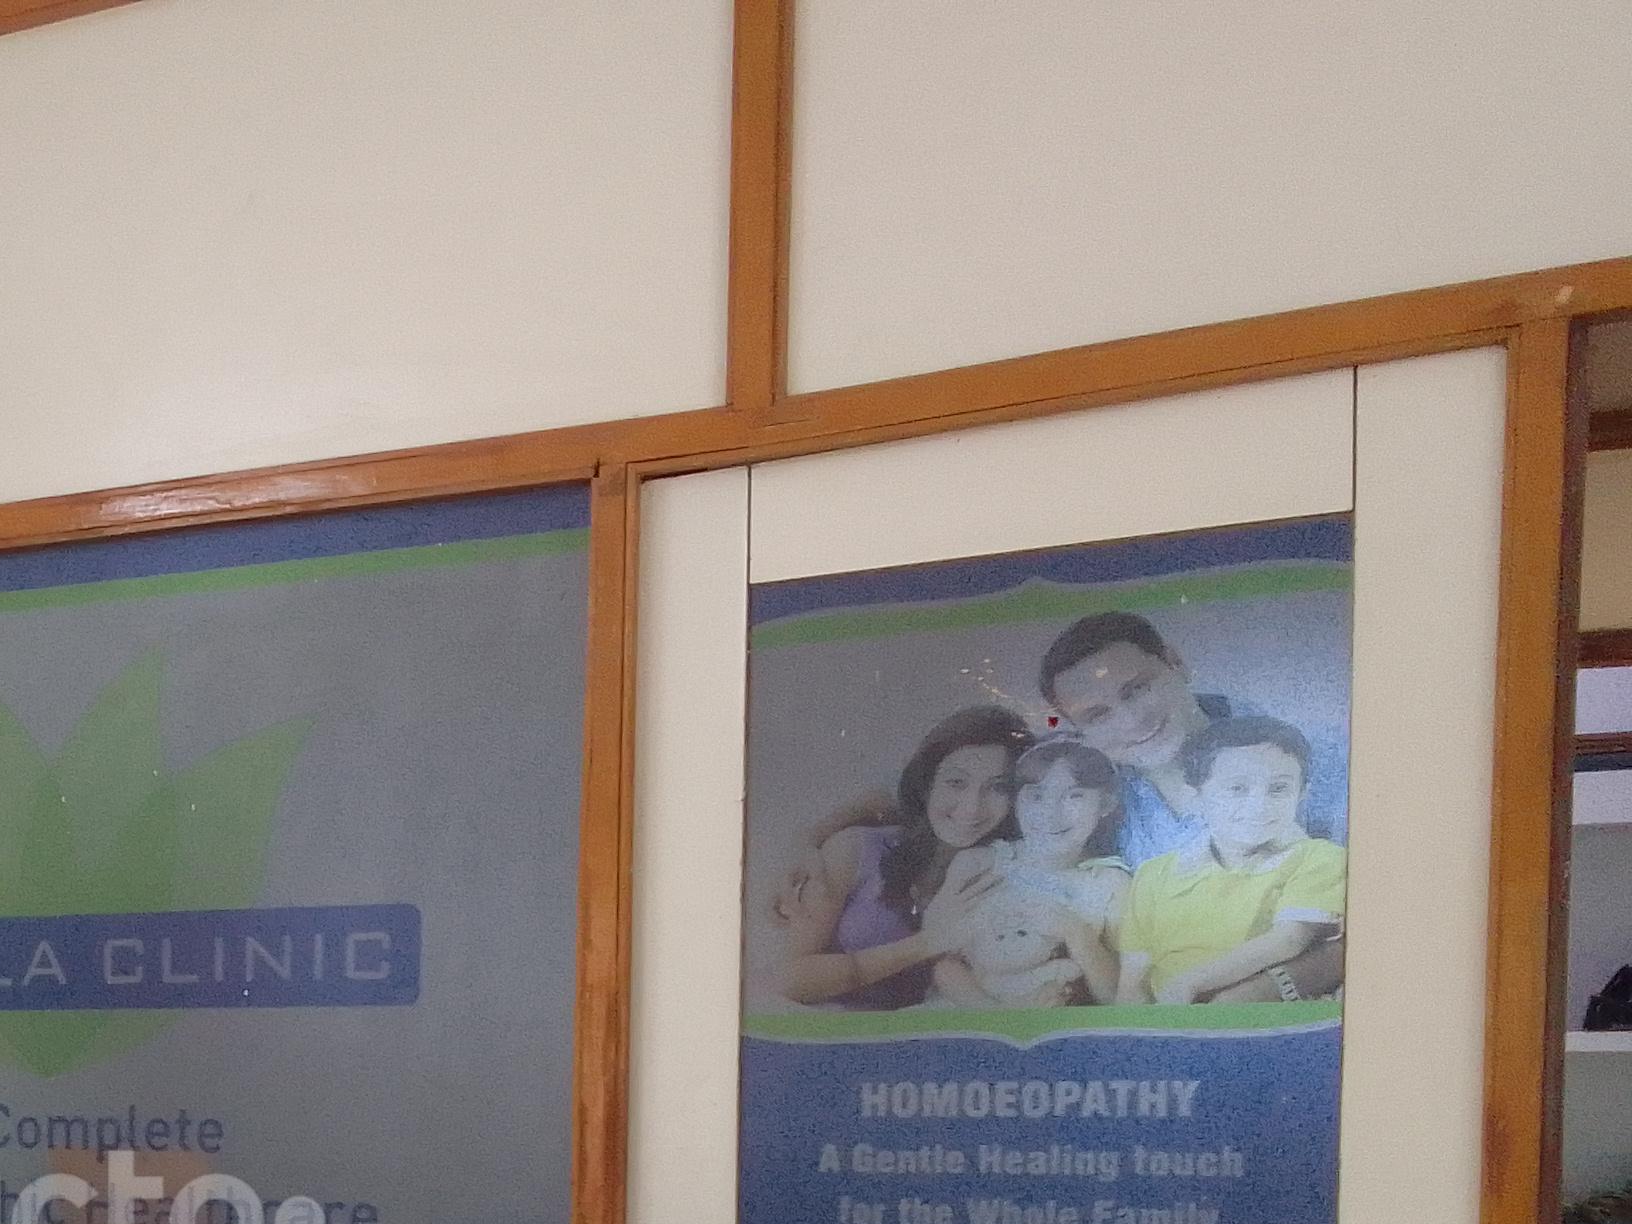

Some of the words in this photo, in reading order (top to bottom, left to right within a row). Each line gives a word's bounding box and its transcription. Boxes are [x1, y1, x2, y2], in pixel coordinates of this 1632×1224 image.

[101, 932, 393, 986] CLINIC
[861, 1079, 1200, 1119] HOMOEOPATHY
[818, 1144, 843, 1174] A
[851, 1142, 964, 1176] Gentle
[978, 1144, 1122, 1183] Healing
[1135, 1145, 1244, 1179] touch
